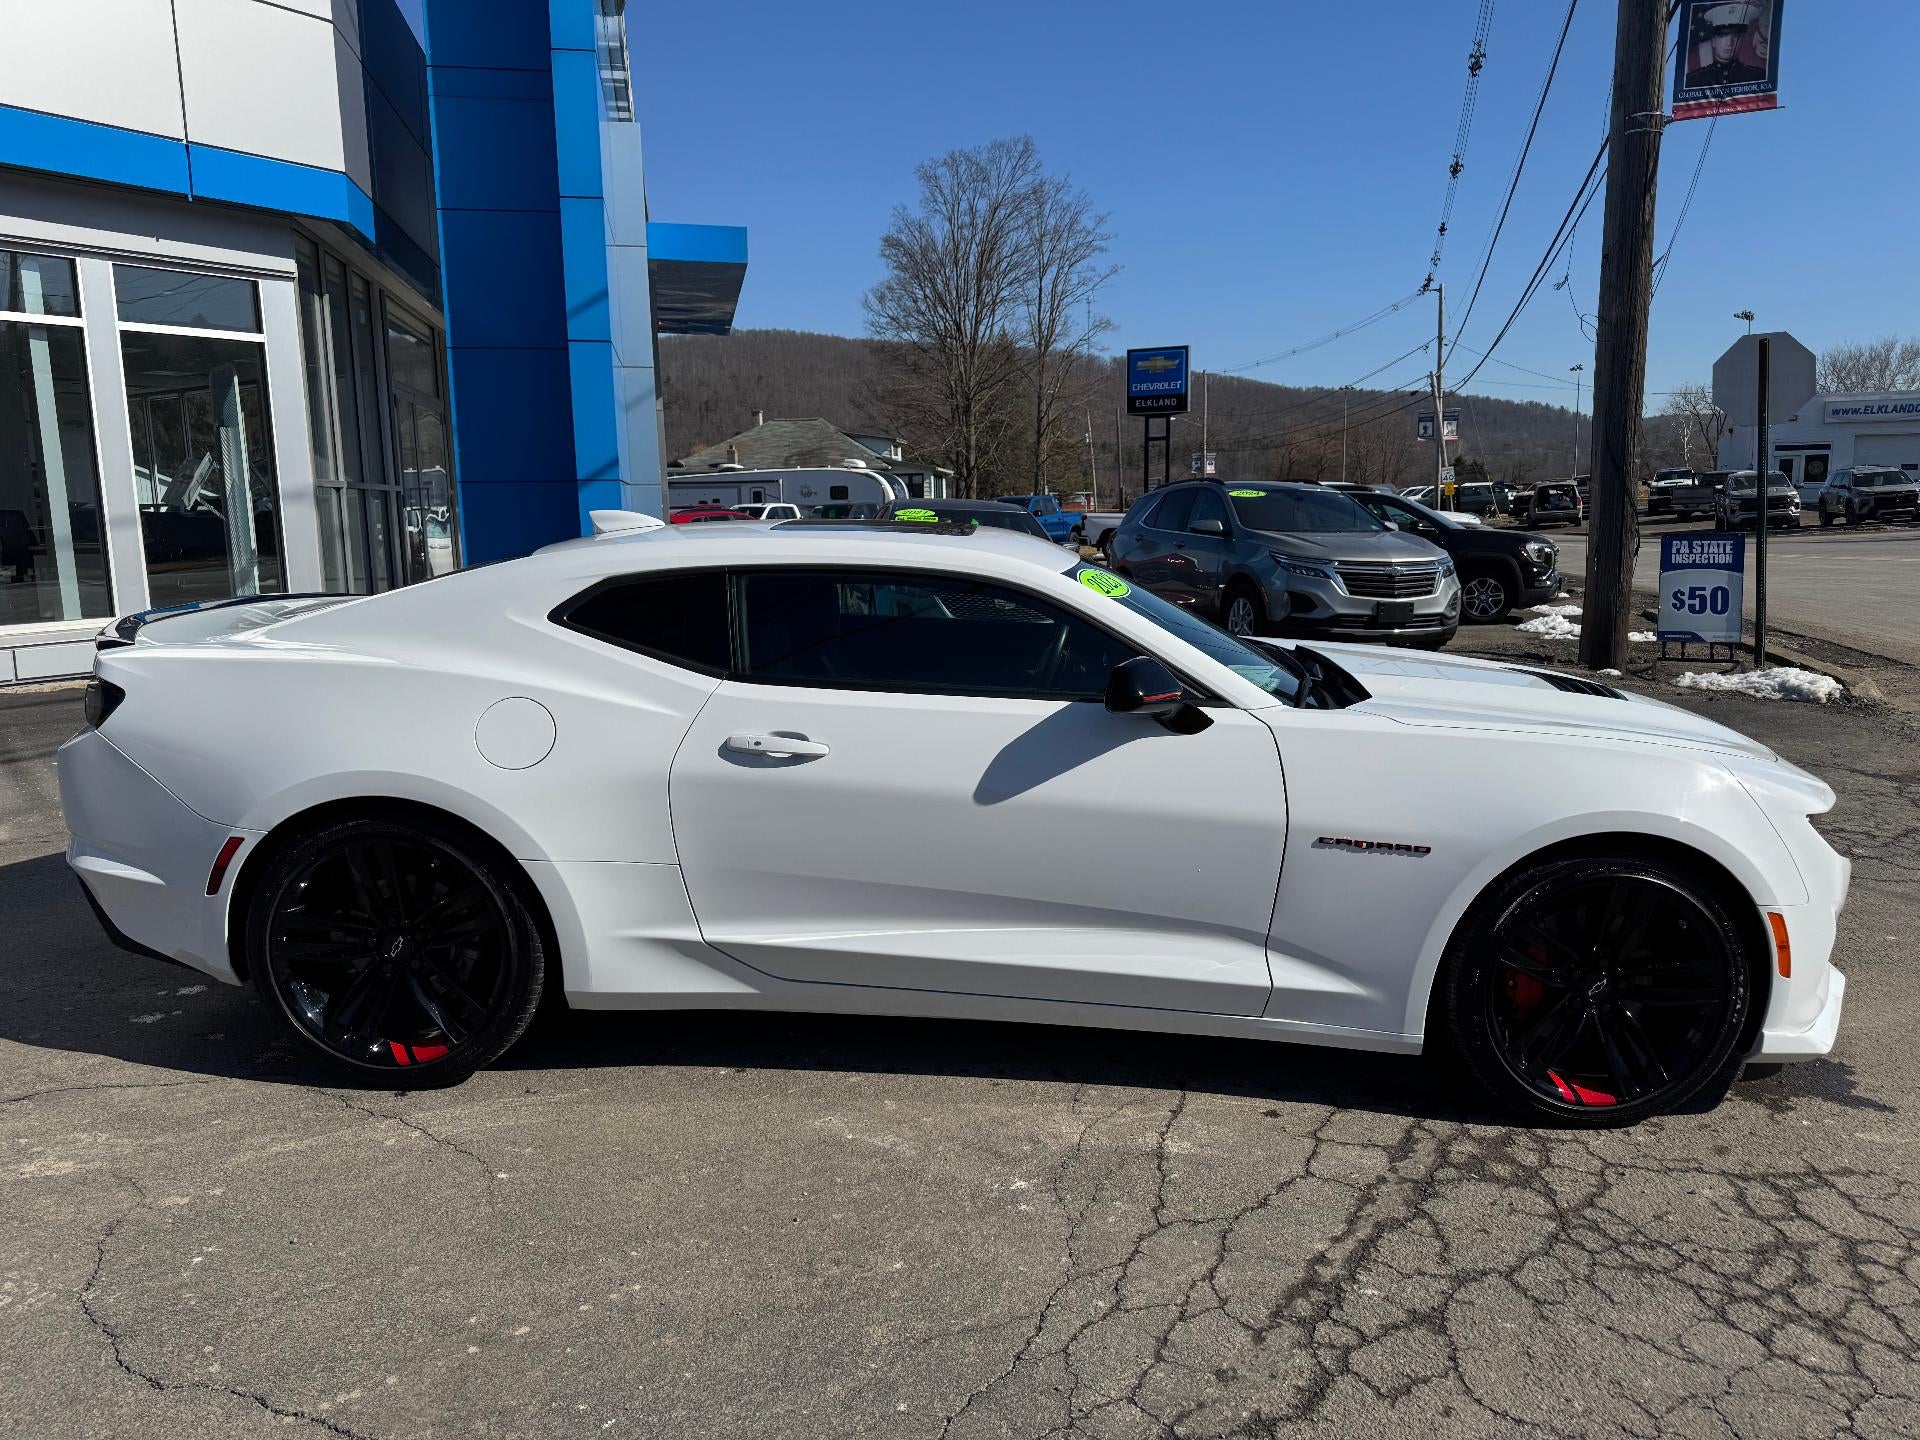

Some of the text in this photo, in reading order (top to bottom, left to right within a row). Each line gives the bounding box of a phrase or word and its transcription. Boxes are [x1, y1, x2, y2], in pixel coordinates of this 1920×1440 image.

[1678, 90, 1704, 99] GLOBAL
[1132, 381, 1182, 391] CHEVROLET
[1135, 398, 1177, 407] ELKLAND
[1671, 540, 1734, 554] PA STATE
[1671, 553, 1733, 564] INSPECTION
[1671, 586, 1730, 615] $50
[1318, 836, 1432, 853] CAMARO
